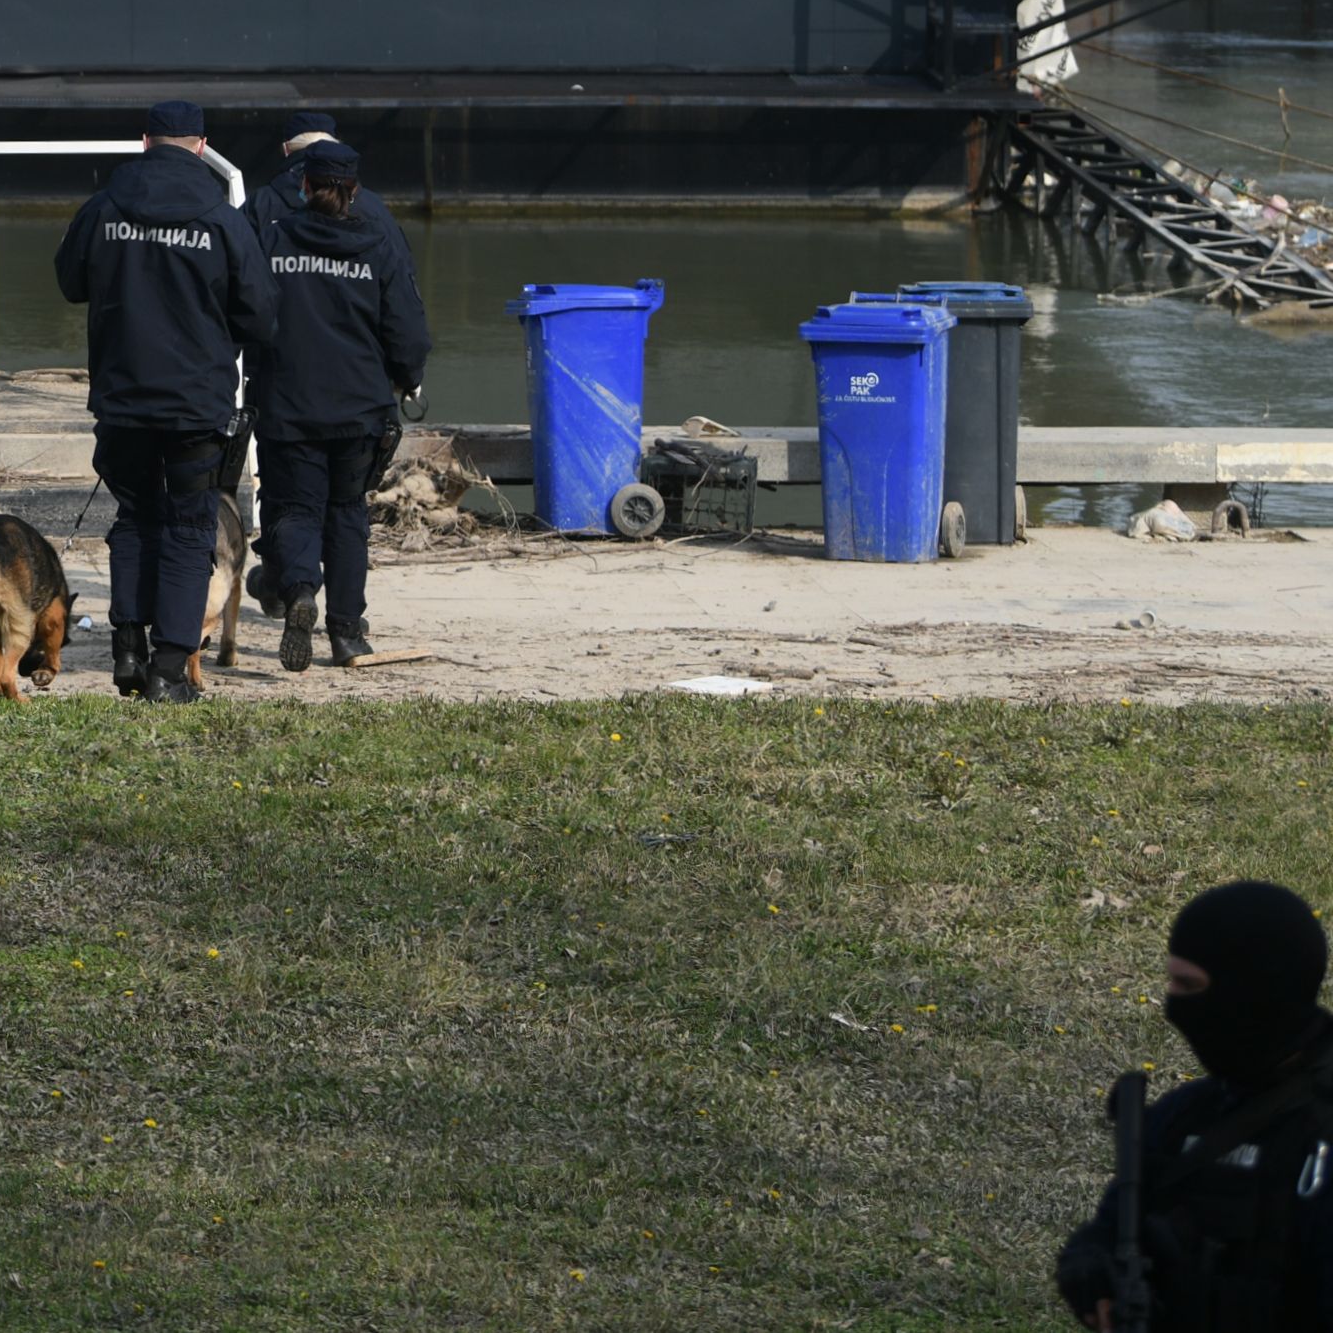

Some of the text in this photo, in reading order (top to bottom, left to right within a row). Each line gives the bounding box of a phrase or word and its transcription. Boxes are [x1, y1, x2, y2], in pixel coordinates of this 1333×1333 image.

[105, 221, 212, 251] ПОЛИЦИЈА
[271, 255, 373, 281] ПОЛИЦИЈА
[850, 386, 870, 395] PAK
